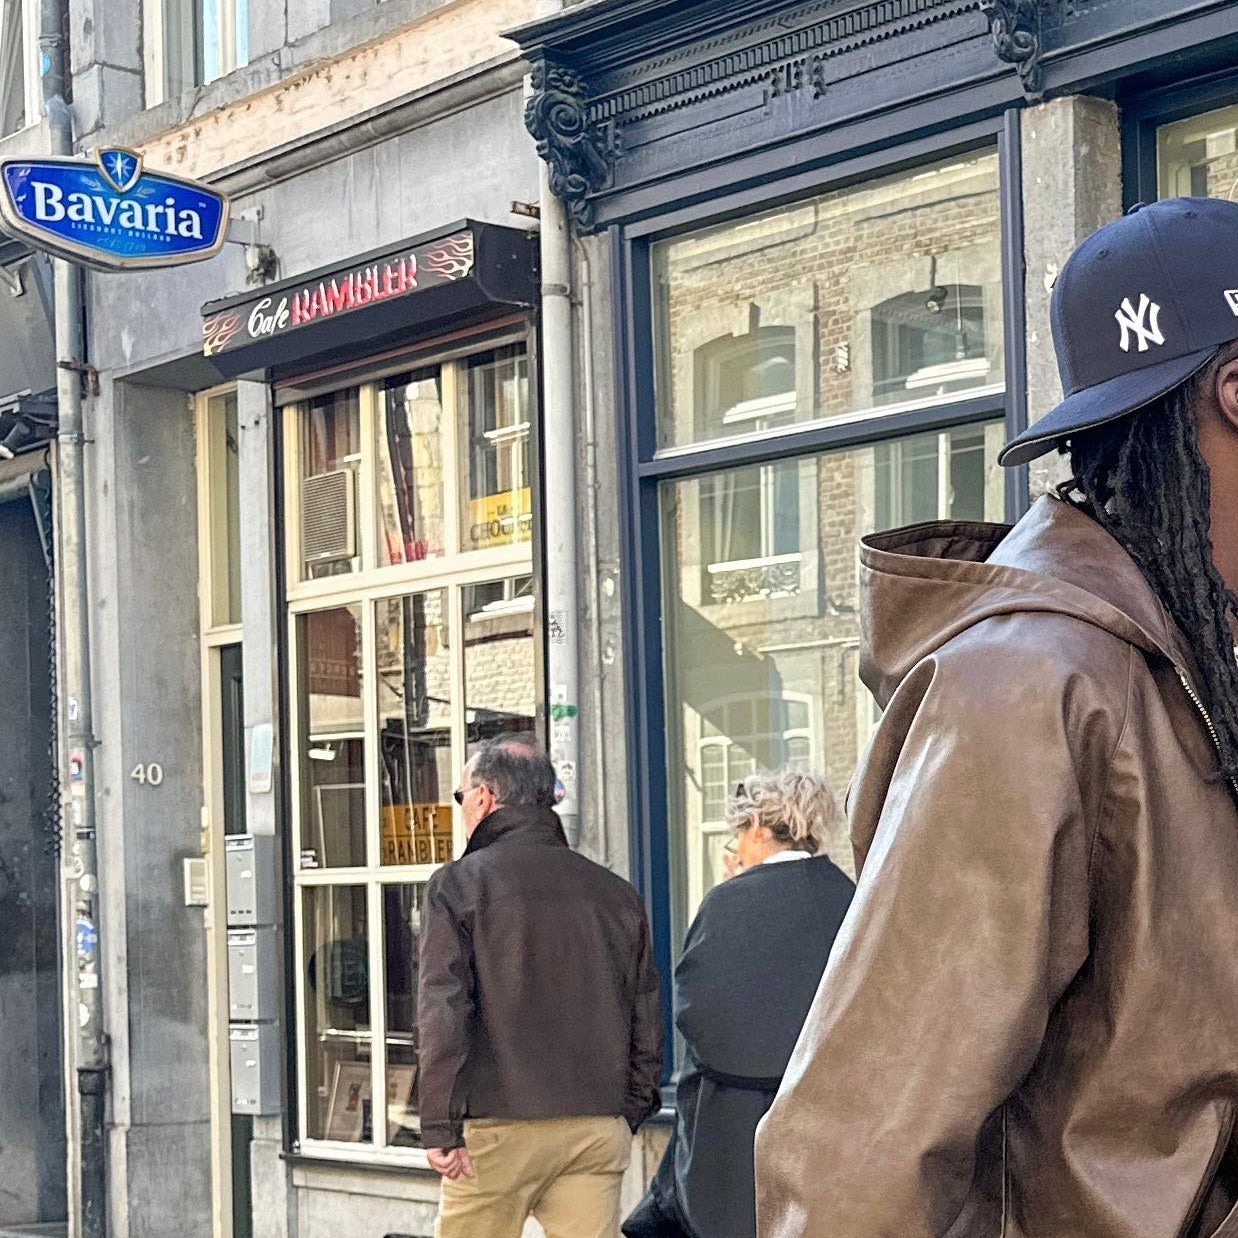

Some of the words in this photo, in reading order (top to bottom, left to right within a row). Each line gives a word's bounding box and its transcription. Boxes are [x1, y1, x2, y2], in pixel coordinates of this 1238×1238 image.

[31, 181, 203, 240] Bavaria
[248, 297, 288, 337] Cafe
[291, 254, 418, 326] RAMBLER
[1114, 293, 1165, 352] NY
[130, 763, 163, 786] 40
